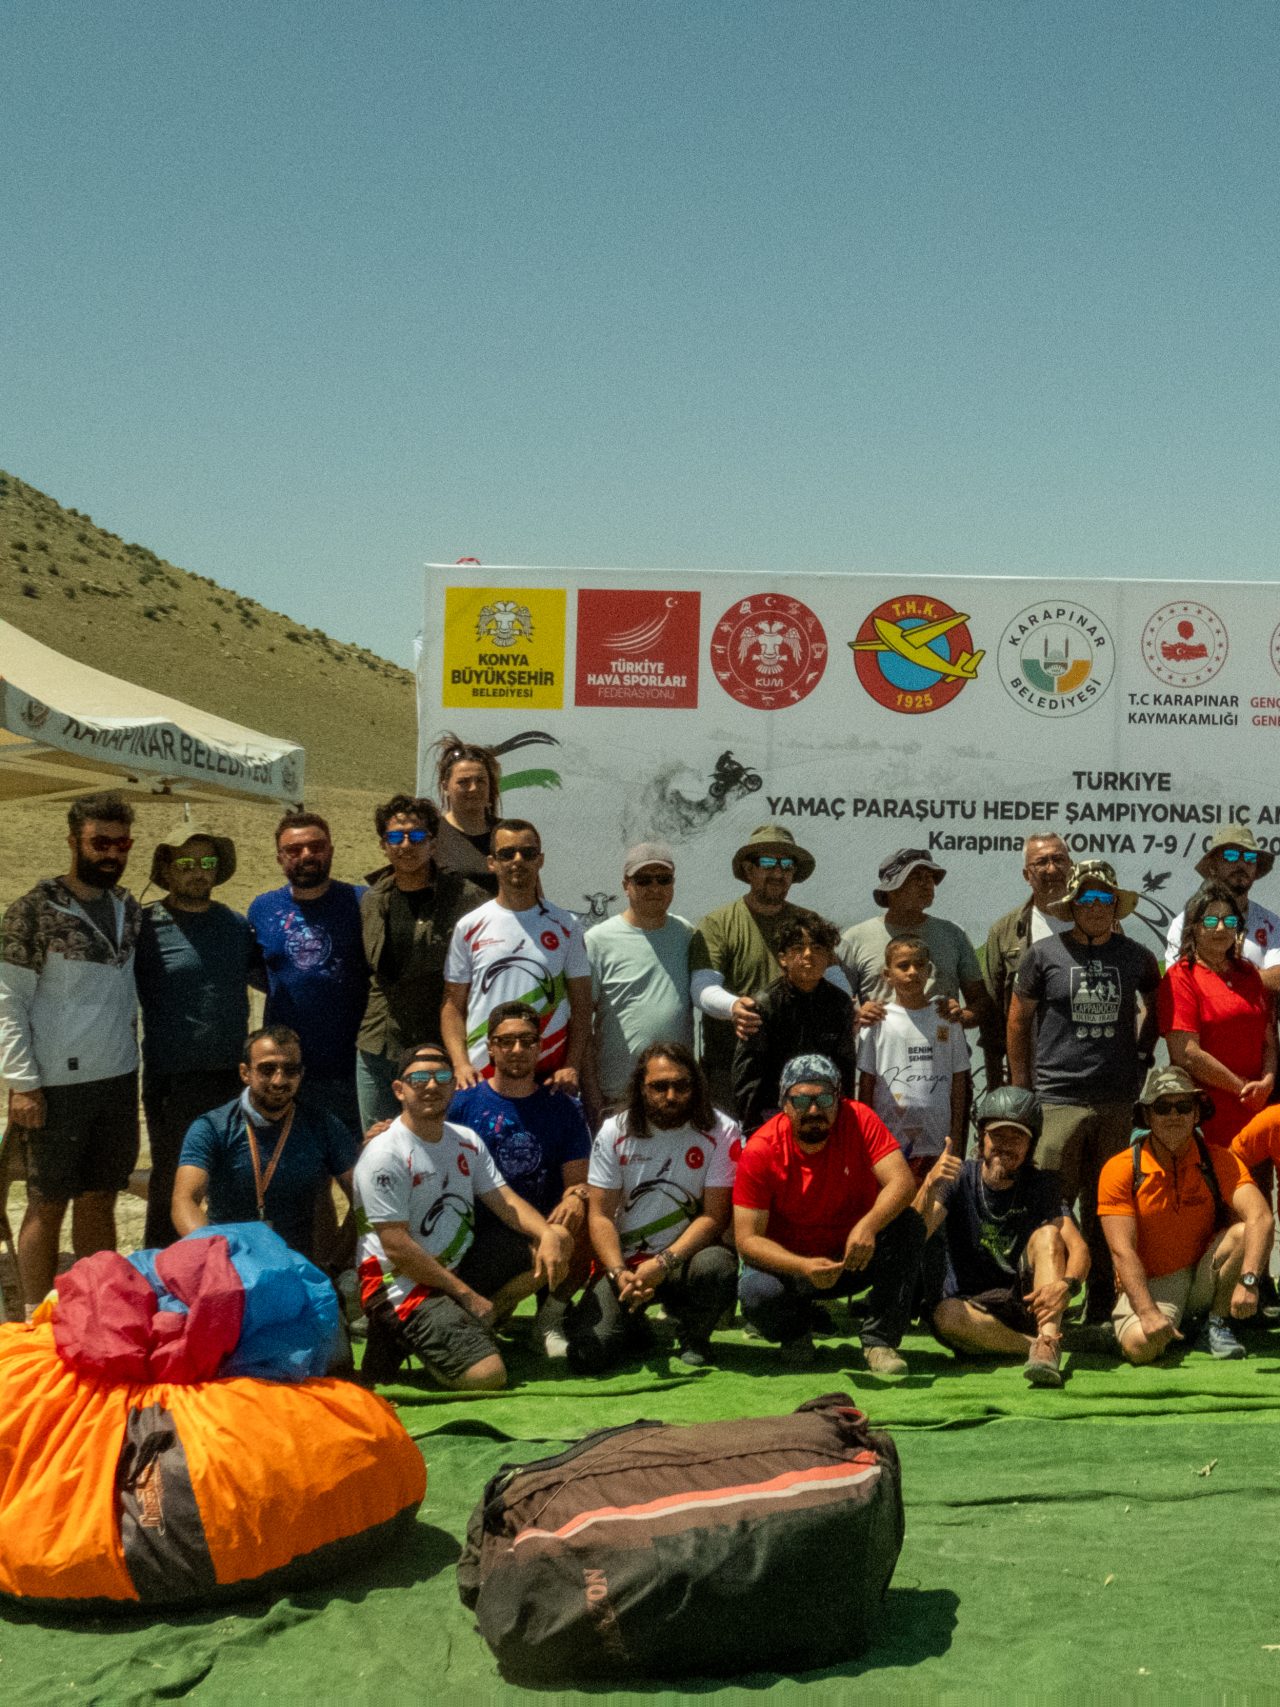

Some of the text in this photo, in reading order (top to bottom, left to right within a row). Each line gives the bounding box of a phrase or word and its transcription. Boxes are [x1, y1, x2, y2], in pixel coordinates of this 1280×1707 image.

[892, 600, 938, 618] T.H.K.
[1008, 608, 1106, 648] KARAPINAR
[478, 654, 529, 666] KONYA
[610, 659, 665, 674] TÜRKİYE
[451, 667, 555, 687] BÜYÜKŞEHİR
[587, 674, 687, 687] HAVA SPORLARI
[755, 678, 784, 687] KUM
[472, 687, 533, 699] BELEDİYESİ
[598, 687, 675, 700] FEDERASYONU
[1010, 676, 1103, 710] BELEDİYESİ
[896, 694, 934, 708] 1925
[1153, 694, 1239, 708] KARAPINAR
[1128, 710, 1238, 726] KAYMAKAMLIĞI
[765, 796, 846, 821] YAMAÇ
[983, 800, 1059, 821] HEDEF
[1065, 801, 1222, 825] ŞAMPİYONASI
[1229, 804, 1251, 826] İÇ
[929, 831, 1024, 854] Karapına
[1143, 834, 1178, 853] 7-9
[881, 1065, 948, 1094] Konya
